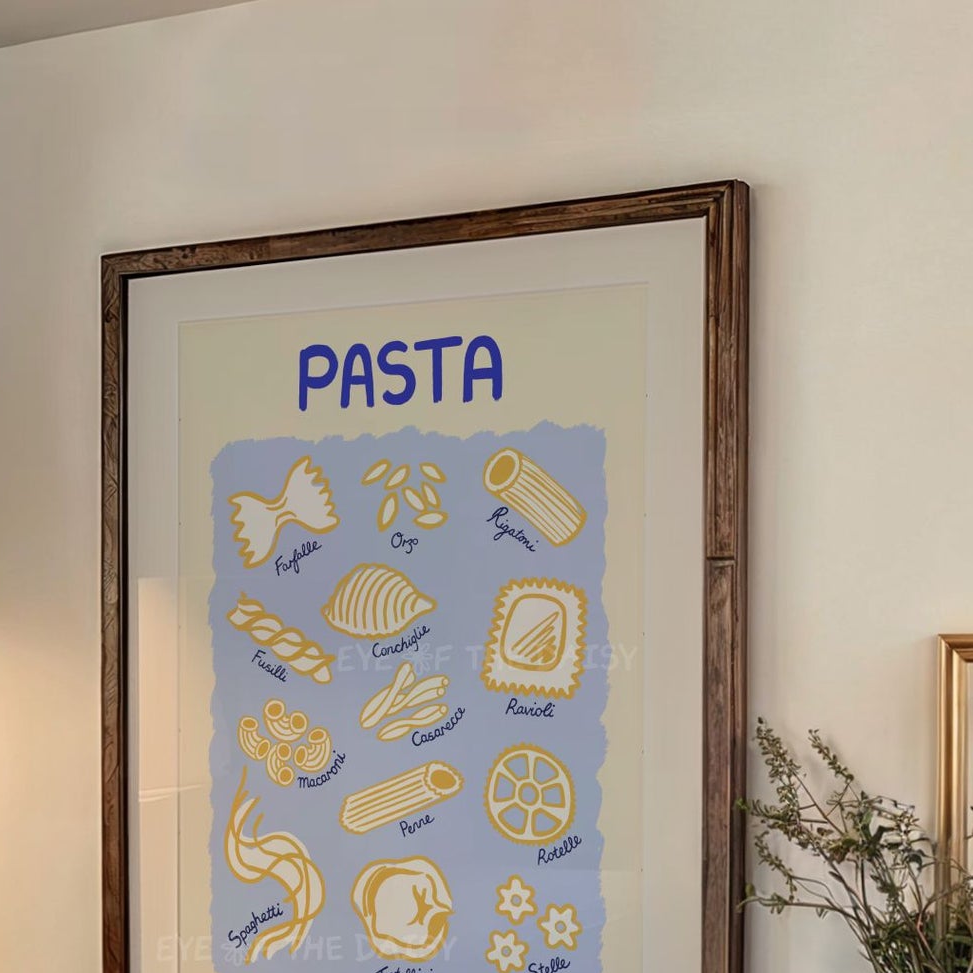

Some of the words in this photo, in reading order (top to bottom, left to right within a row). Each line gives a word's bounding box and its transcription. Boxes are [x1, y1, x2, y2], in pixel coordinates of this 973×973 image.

[298, 335, 503, 412] PASTA
[390, 531, 419, 555] Orzo
[486, 506, 540, 553] Rigatoni
[275, 540, 323, 577] Farfalle
[371, 625, 431, 659] Conchiglie
[251, 649, 289, 683] Fusilli
[504, 697, 556, 718] Ravioli
[411, 707, 466, 747] Casarecce
[297, 750, 346, 789] Macaroni
[399, 814, 436, 838] Penne
[537, 835, 583, 866] Rotelle
[228, 902, 284, 949] Spaghetti
